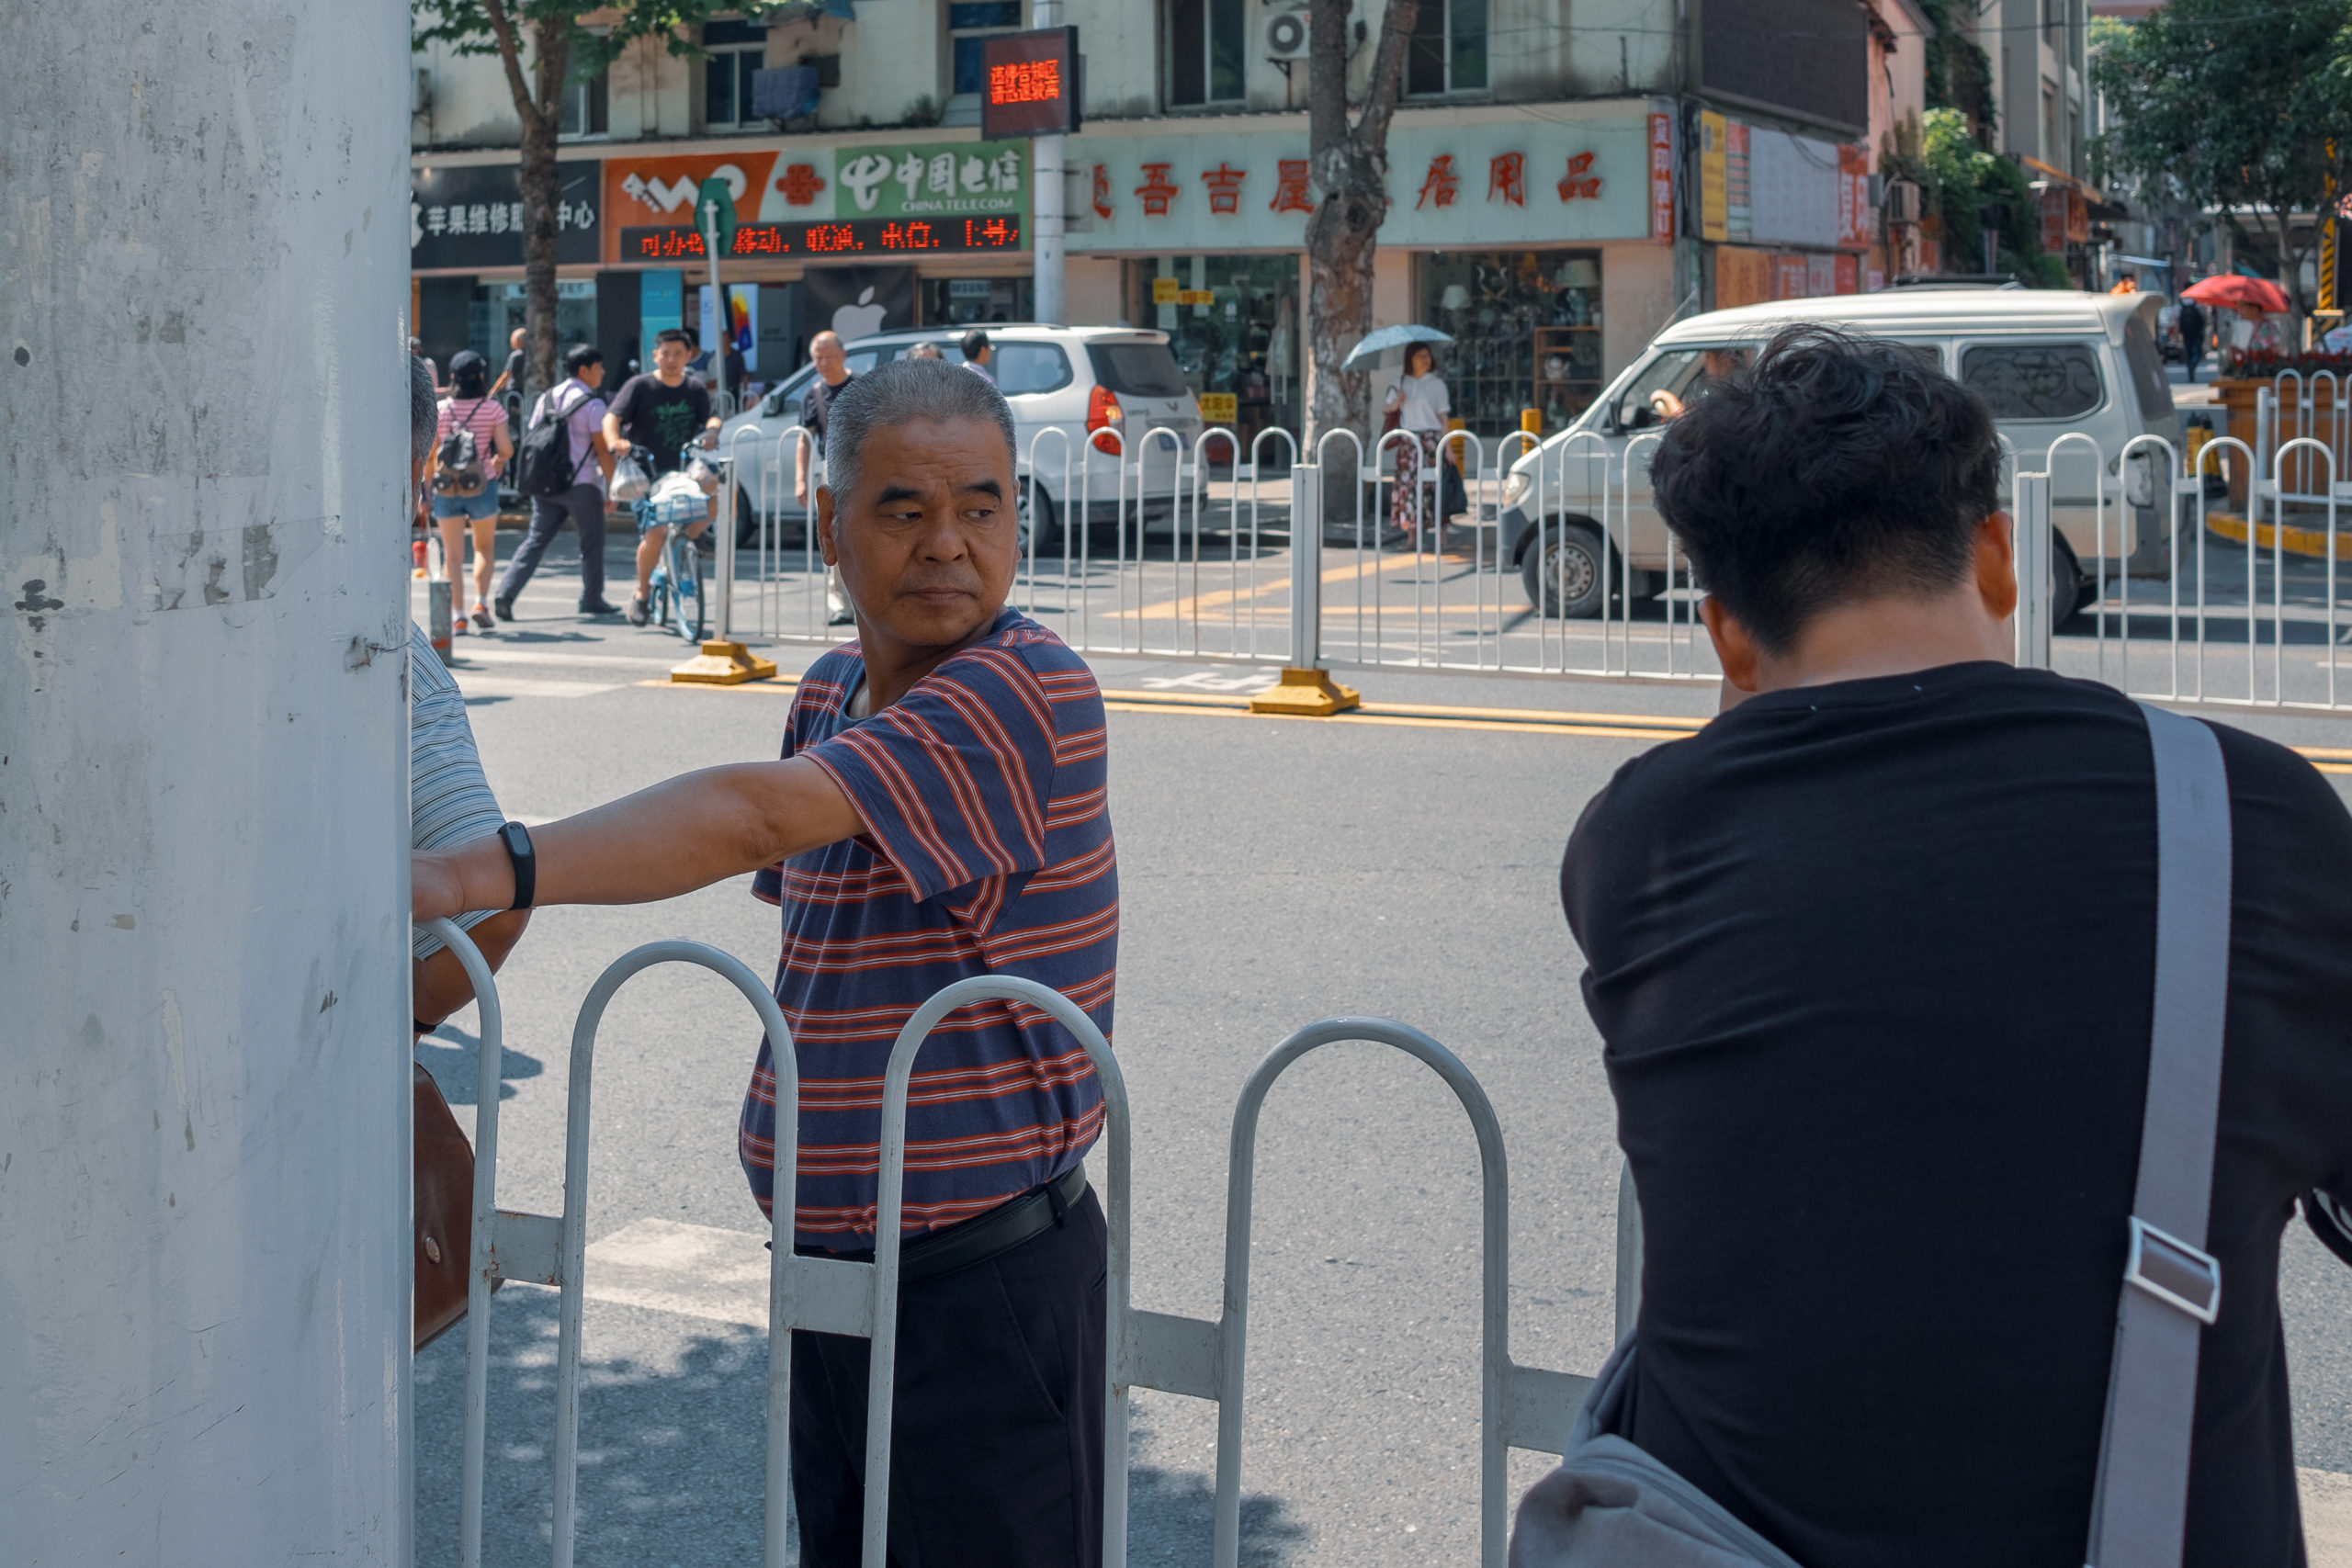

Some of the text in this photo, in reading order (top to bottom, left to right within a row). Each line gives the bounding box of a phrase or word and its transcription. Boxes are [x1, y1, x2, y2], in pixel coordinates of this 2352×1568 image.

[896, 150, 1021, 199] 中国电信
[1093, 151, 1600, 219] 吾吉屋居用品
[426, 200, 595, 236] 苹果维修服中心
[900, 197, 1014, 212] CHINA TELECOM
